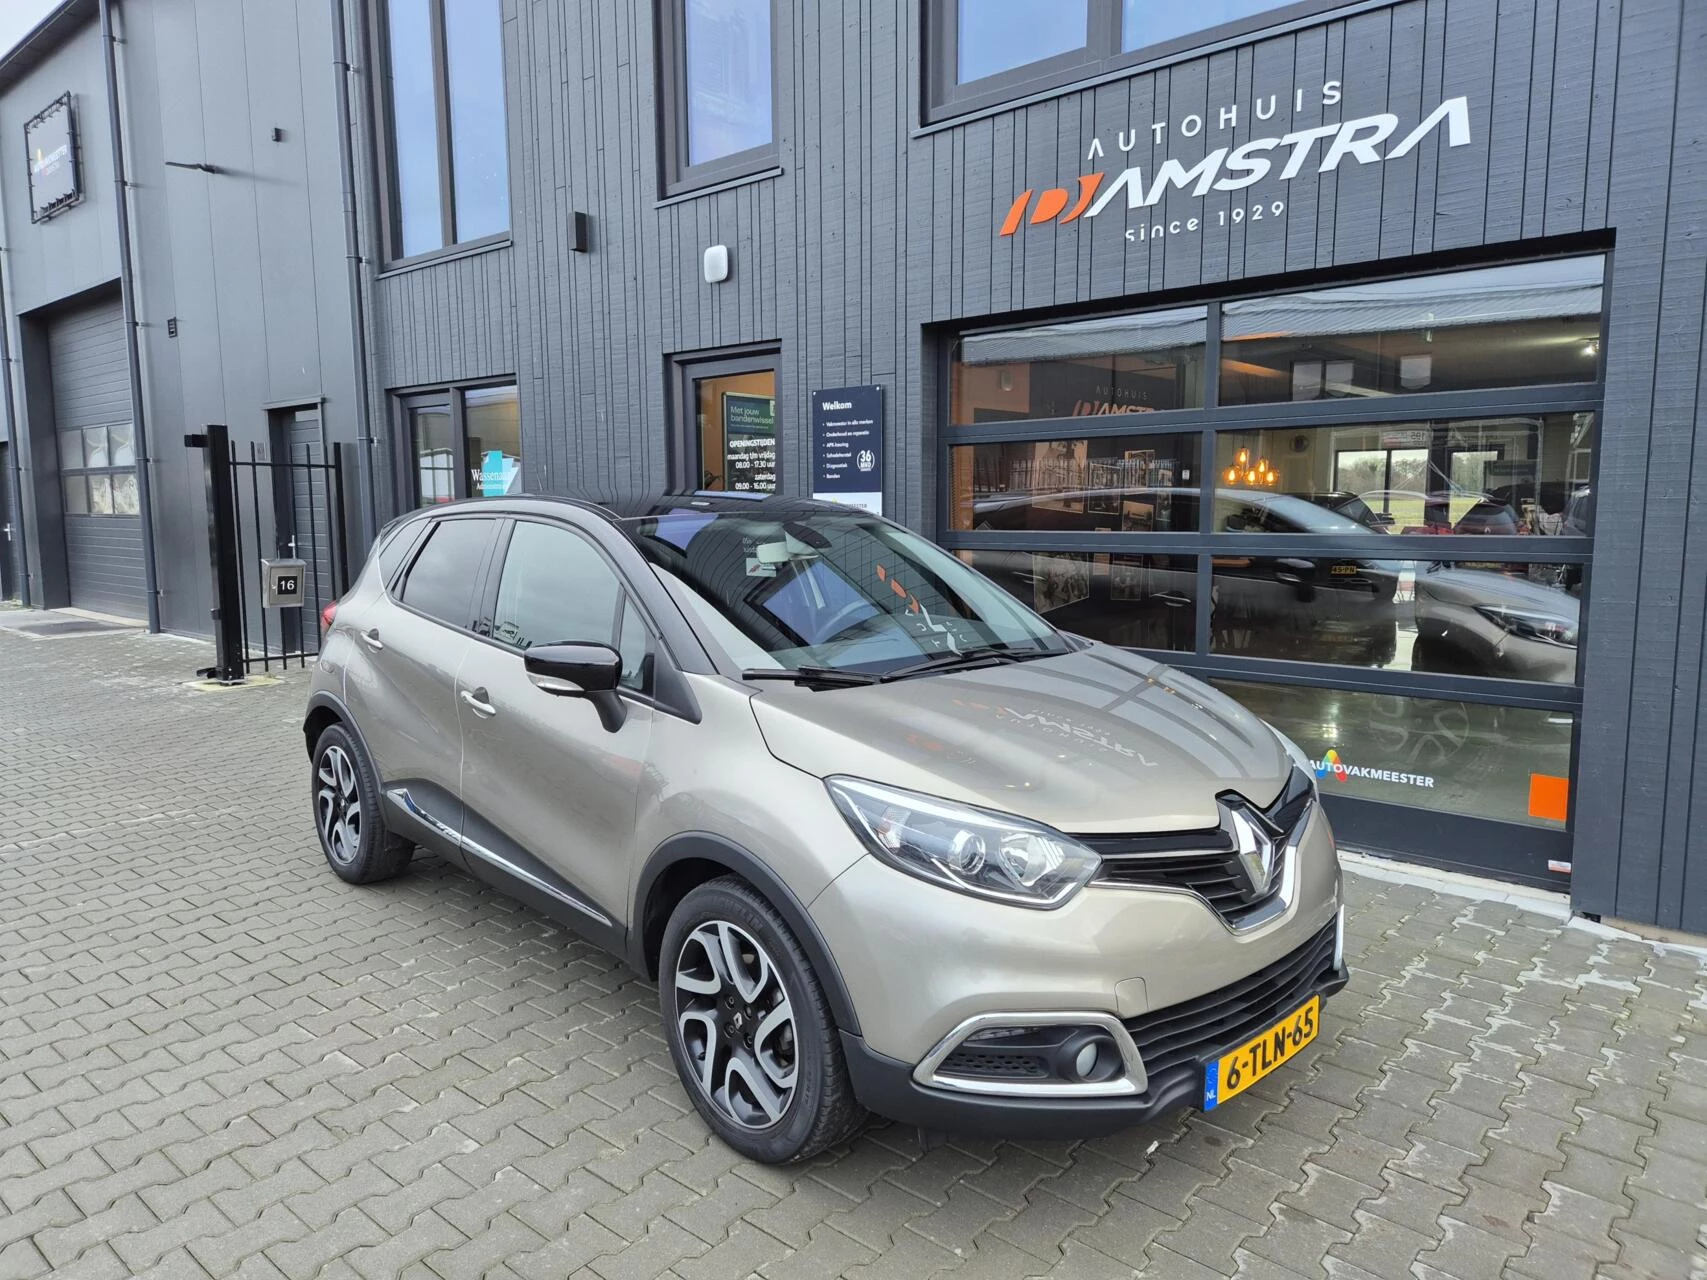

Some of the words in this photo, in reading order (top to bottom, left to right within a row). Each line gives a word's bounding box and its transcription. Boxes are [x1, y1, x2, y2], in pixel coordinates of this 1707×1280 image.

[1087, 80, 1342, 161] AUTOHUIS
[1124, 216, 1200, 243] since
[1217, 200, 1286, 227] 1929
[1095, 384, 1149, 401] AUTOHUIS
[730, 406, 743, 414] Met
[744, 408, 760, 416] jouw
[822, 400, 853, 411] Welkom
[729, 438, 776, 448] OPENINGSTIJDEN
[860, 449, 872, 462] 36
[279, 579, 295, 591] 16
[1226, 1006, 1314, 1090] 6-TLN-65
[1206, 1089, 1216, 1102] NL
